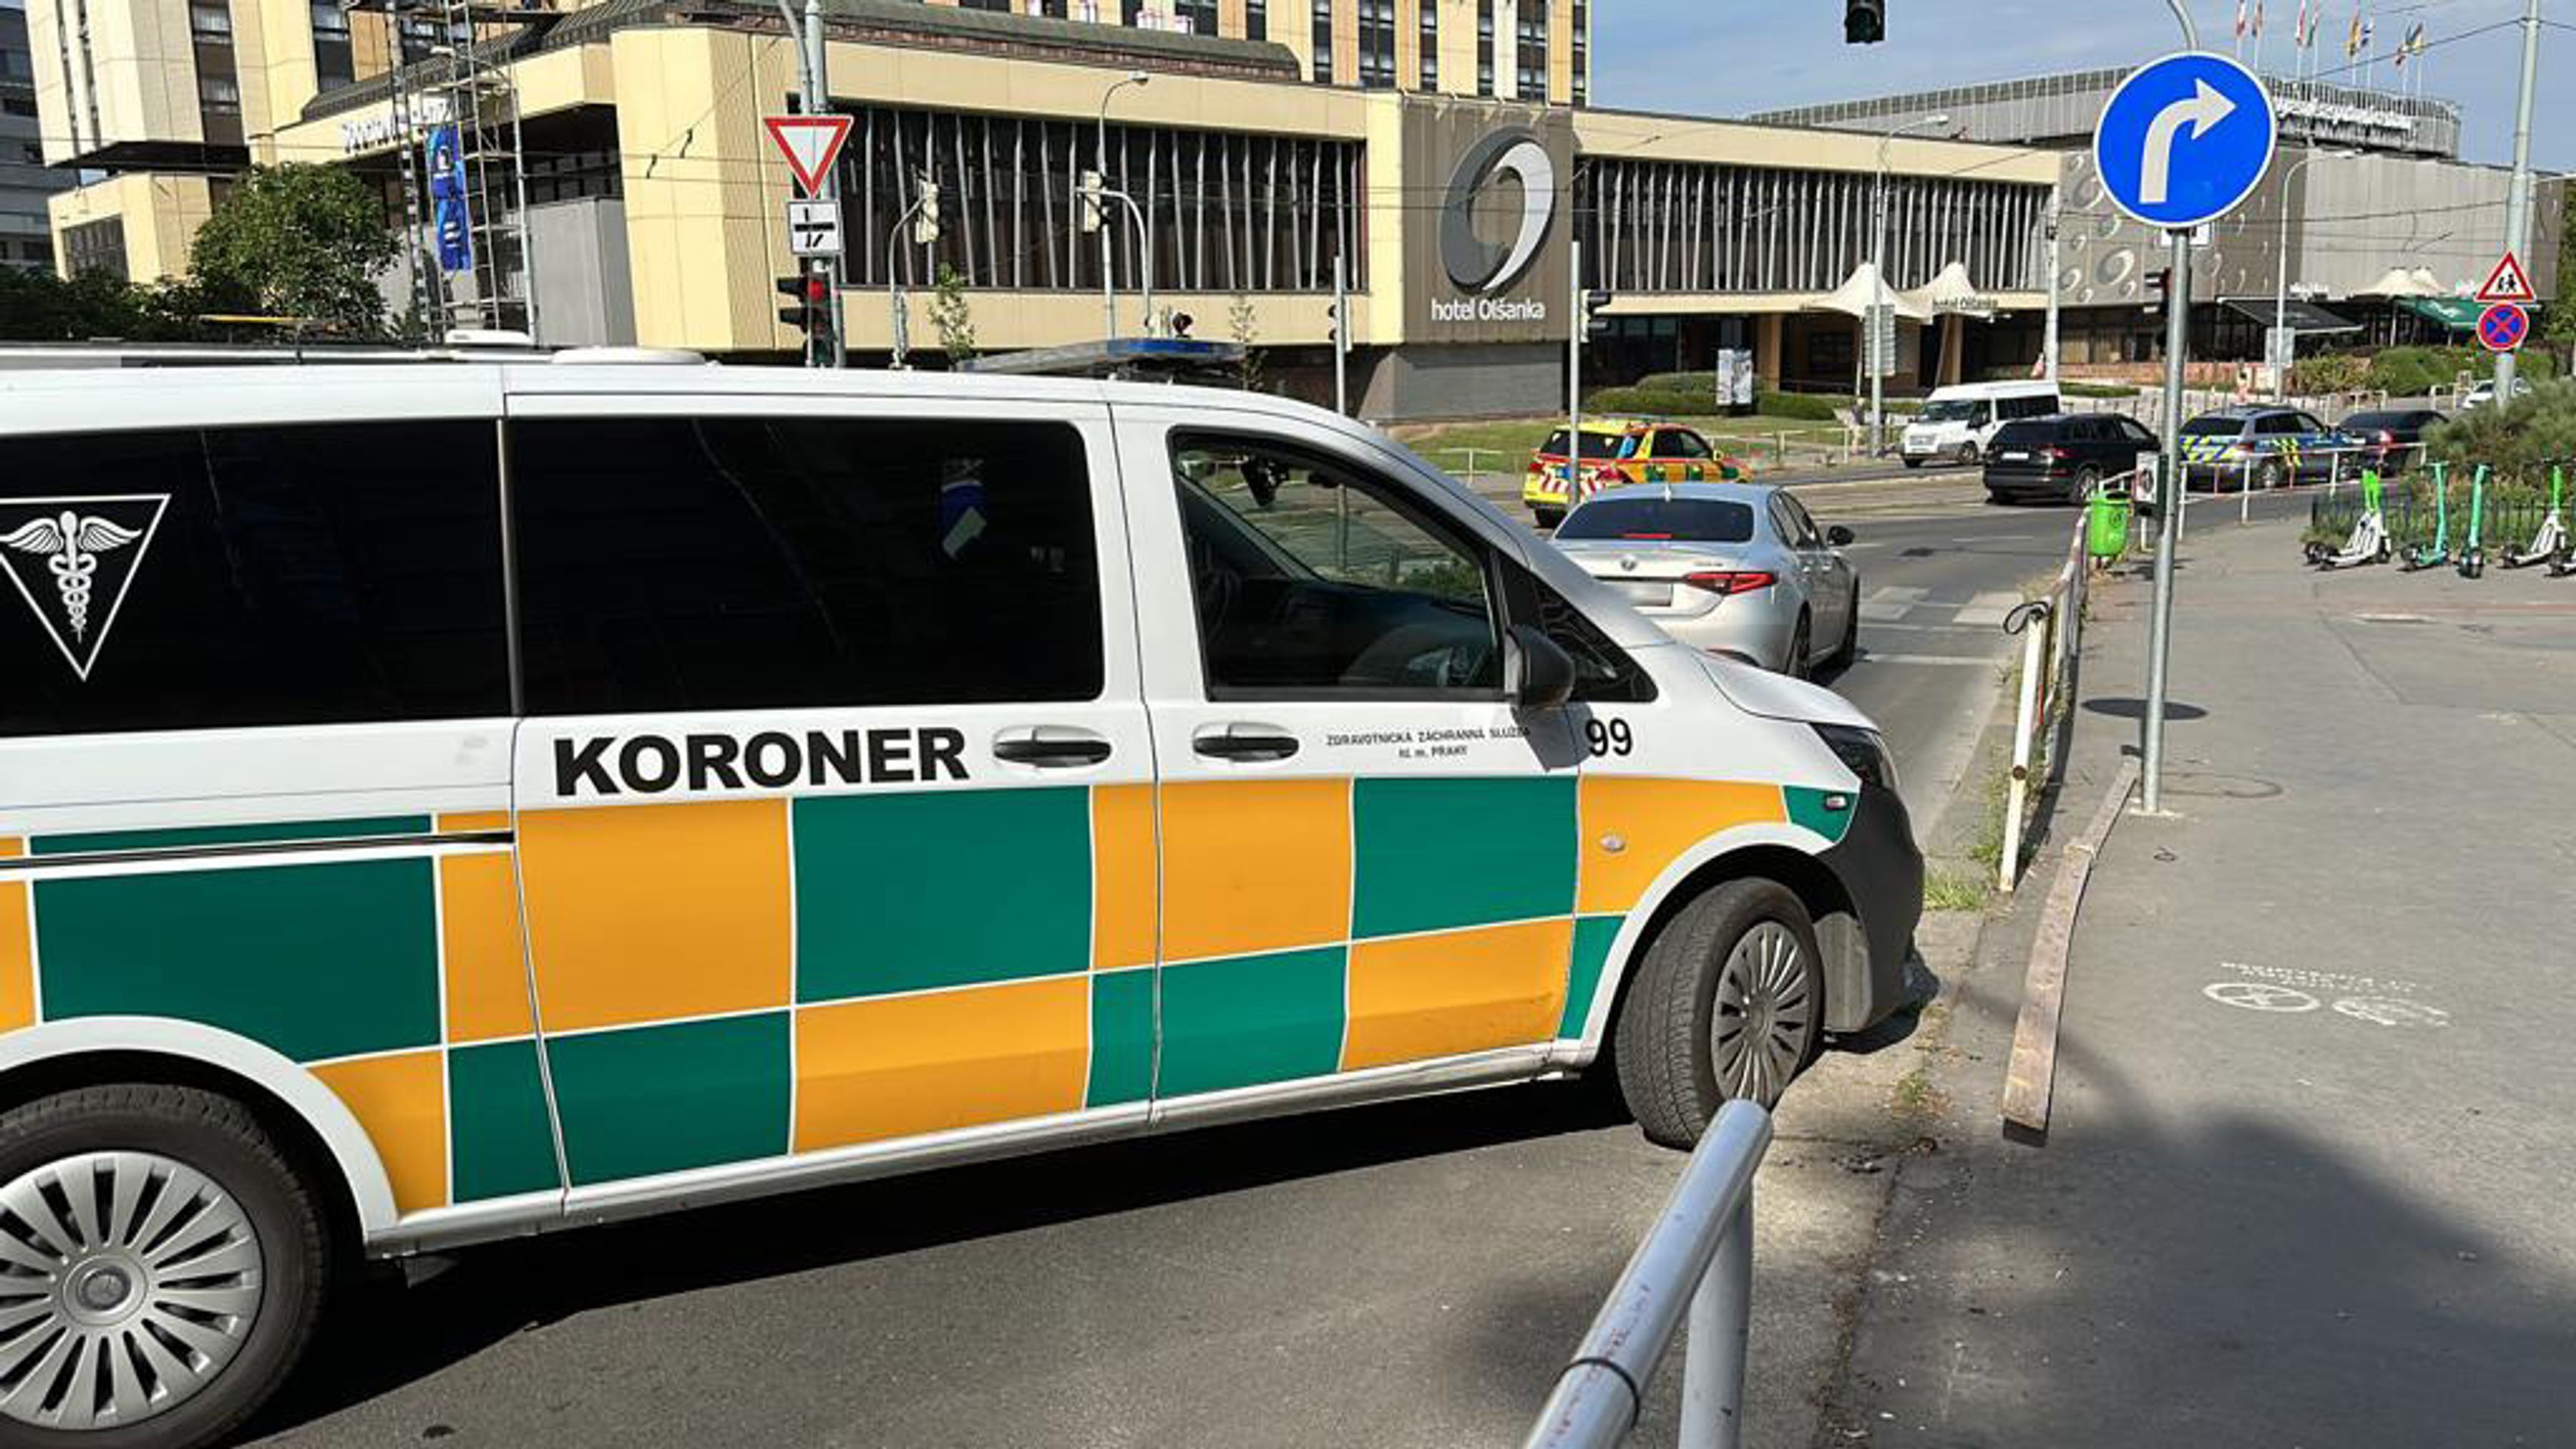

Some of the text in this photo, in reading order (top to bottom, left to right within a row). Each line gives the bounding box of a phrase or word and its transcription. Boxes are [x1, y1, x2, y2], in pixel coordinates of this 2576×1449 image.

[1431, 297, 1546, 321] hotel Olšanka
[1586, 717, 1633, 757] 99
[554, 728, 969, 796] KORONER
